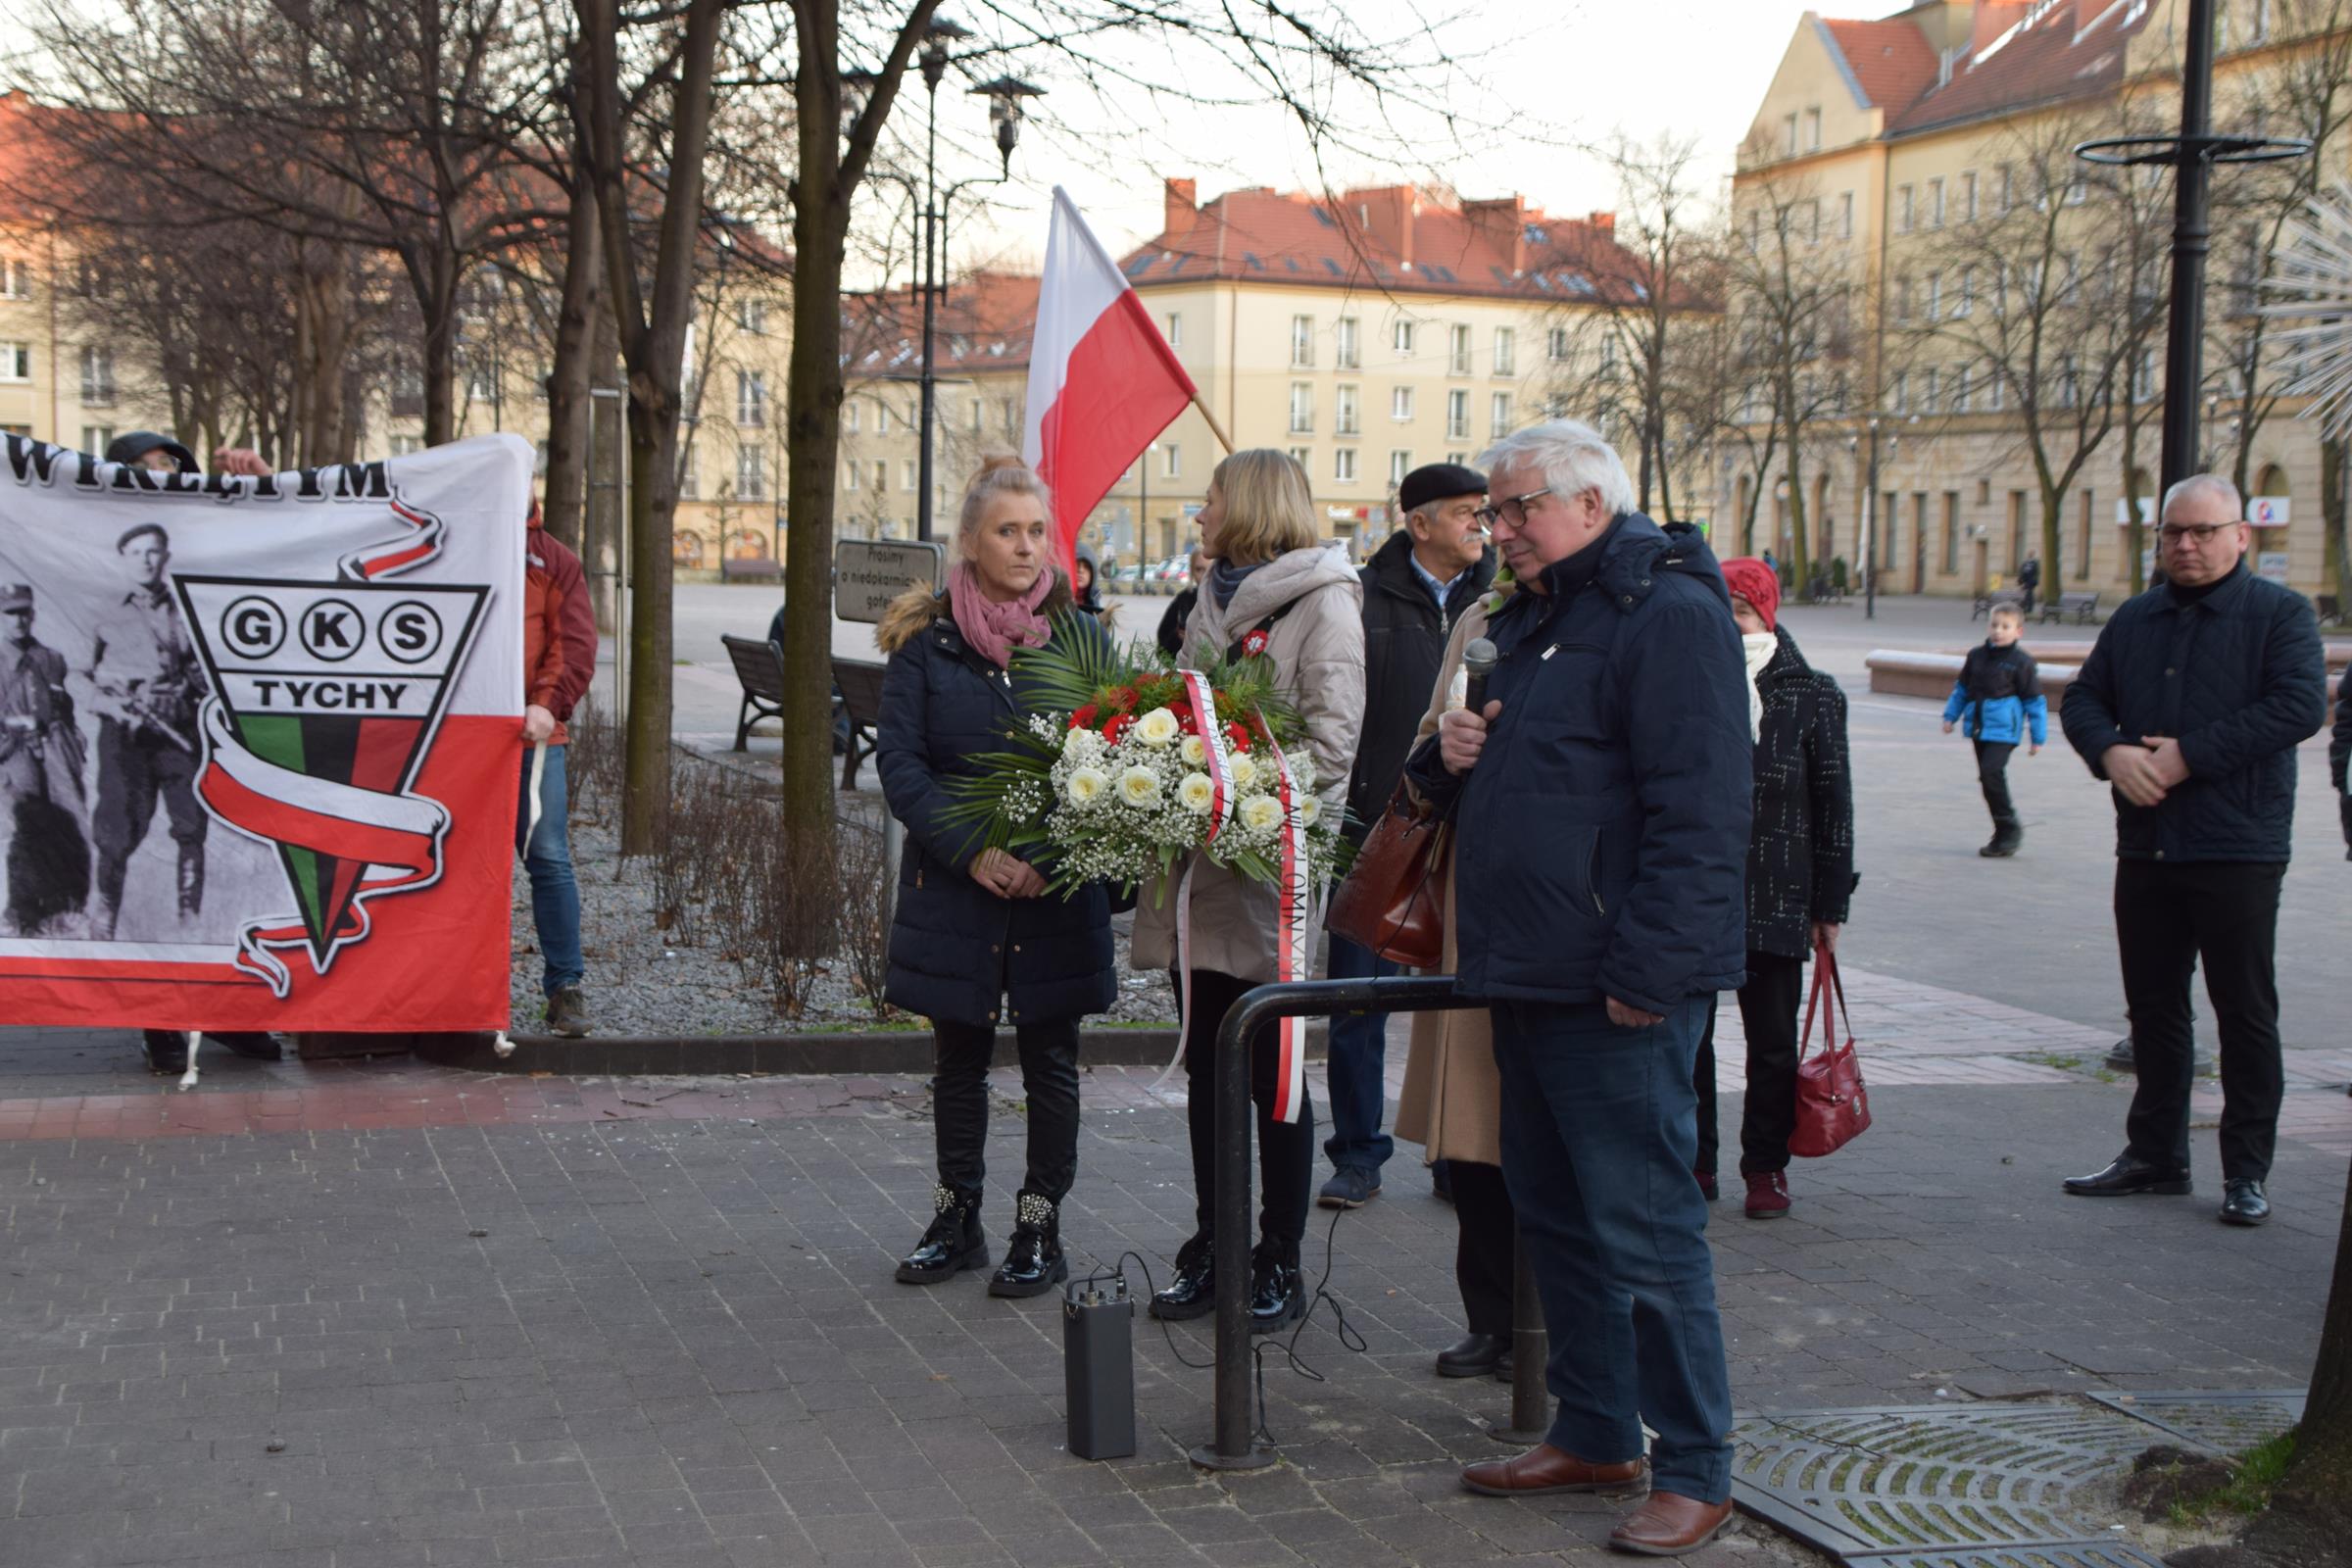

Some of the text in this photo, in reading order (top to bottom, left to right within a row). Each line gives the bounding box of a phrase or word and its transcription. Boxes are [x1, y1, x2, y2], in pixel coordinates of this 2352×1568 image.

[867, 546, 904, 567] Prosimy
[841, 571, 848, 583] o
[253, 680, 408, 709] TYCHY
